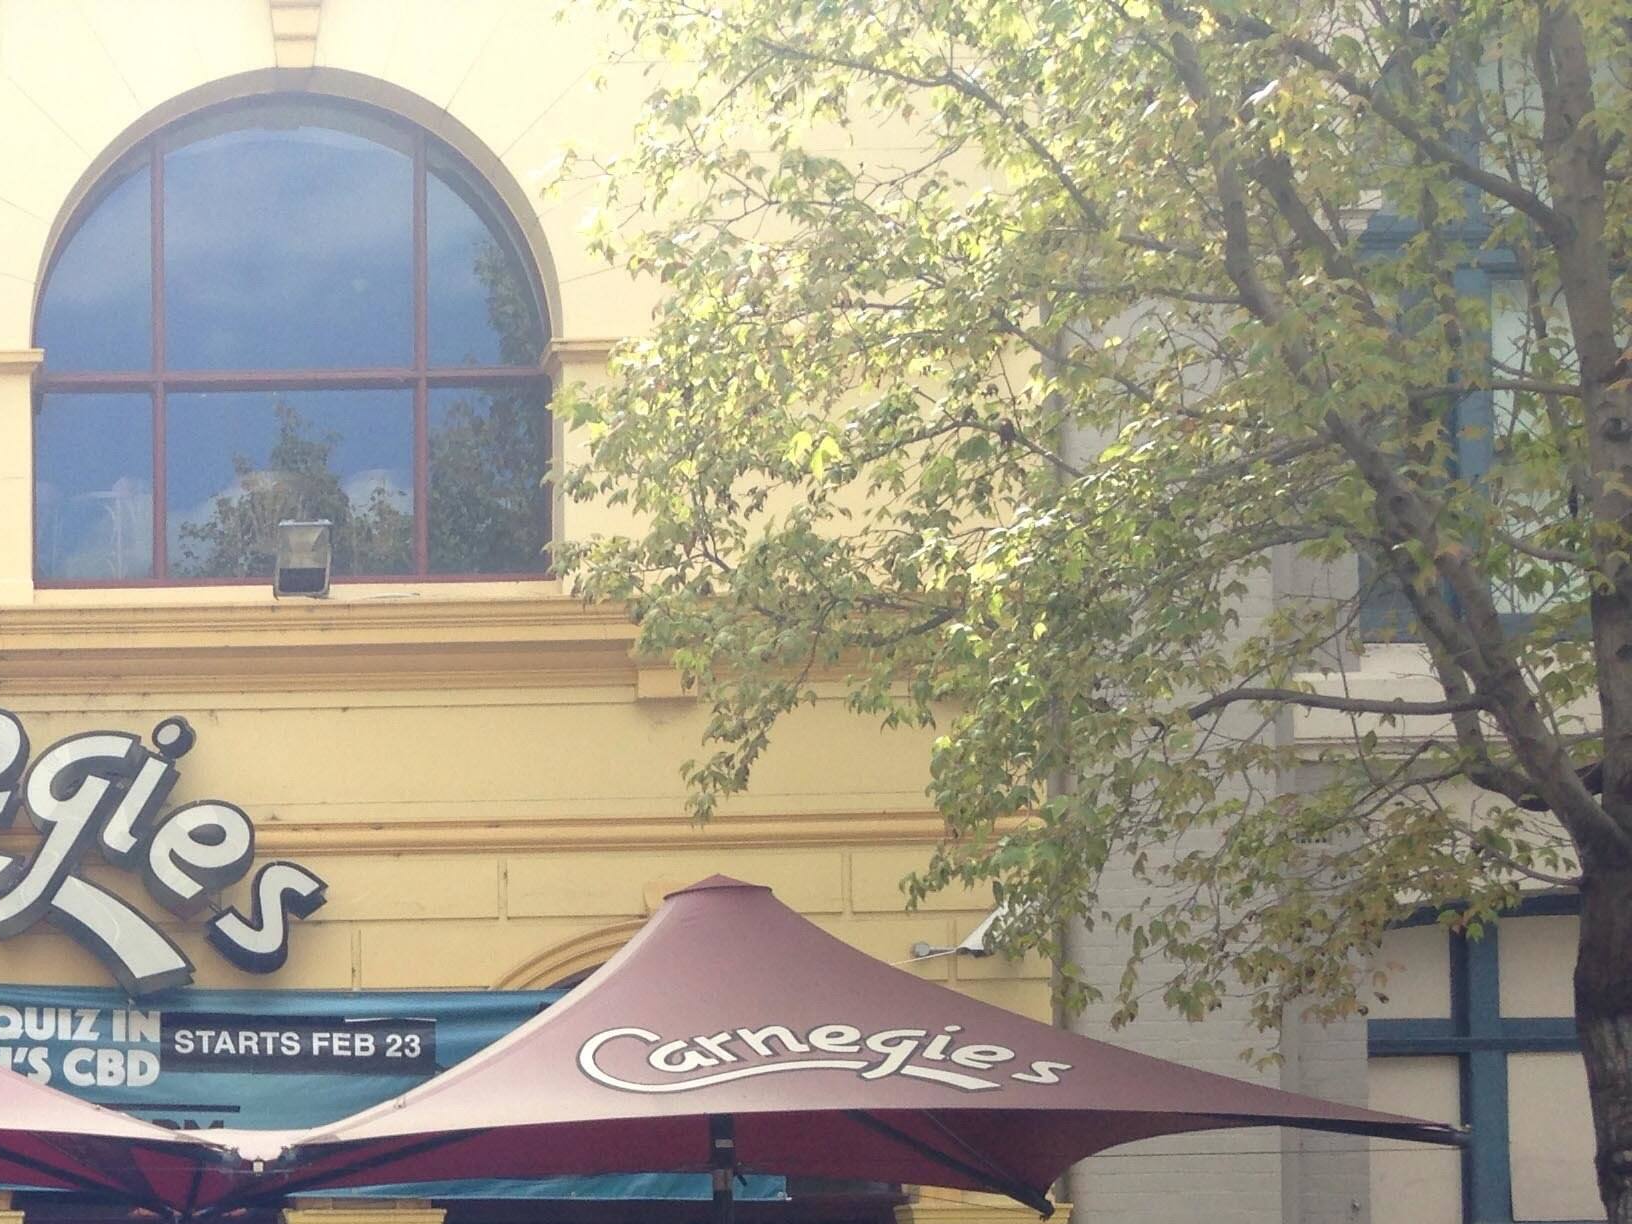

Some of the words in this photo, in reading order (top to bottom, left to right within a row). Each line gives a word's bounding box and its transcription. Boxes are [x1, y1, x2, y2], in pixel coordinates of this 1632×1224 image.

[112, 1010, 161, 1043] IN
[174, 1029, 301, 1056] STARTS
[312, 1031, 377, 1058] FEB
[384, 1033, 423, 1059] 23
[62, 1048, 161, 1088] CBD
[576, 1022, 1074, 1094] Carnegies
